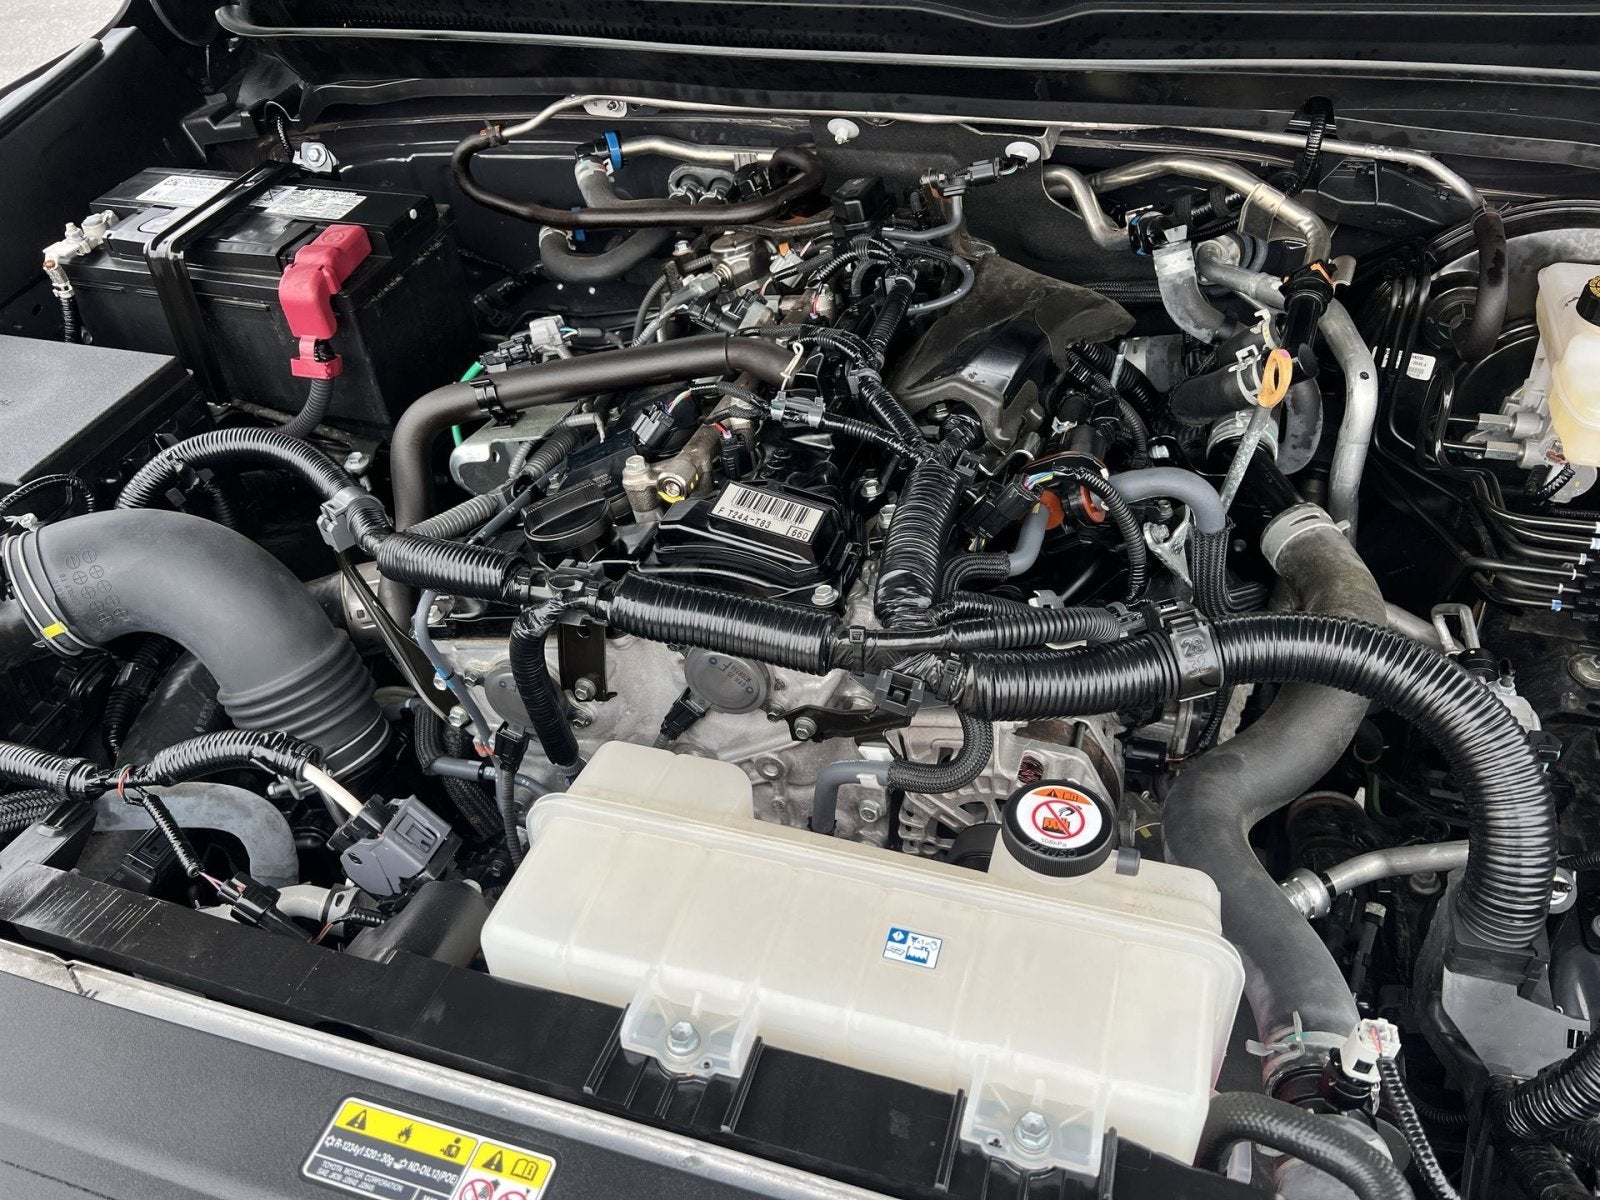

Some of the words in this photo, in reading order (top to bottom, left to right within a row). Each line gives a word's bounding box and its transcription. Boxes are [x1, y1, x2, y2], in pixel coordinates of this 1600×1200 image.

[727, 509, 772, 529] T24A-T83
[1180, 636, 1207, 658] 28
[1026, 841, 1078, 858] DENSO
[334, 1138, 366, 1157] R-1234yf
[321, 1160, 344, 1173] TOYOTA
[343, 1167, 365, 1179] MOTOR
[364, 1173, 404, 1193] CORPORATION
